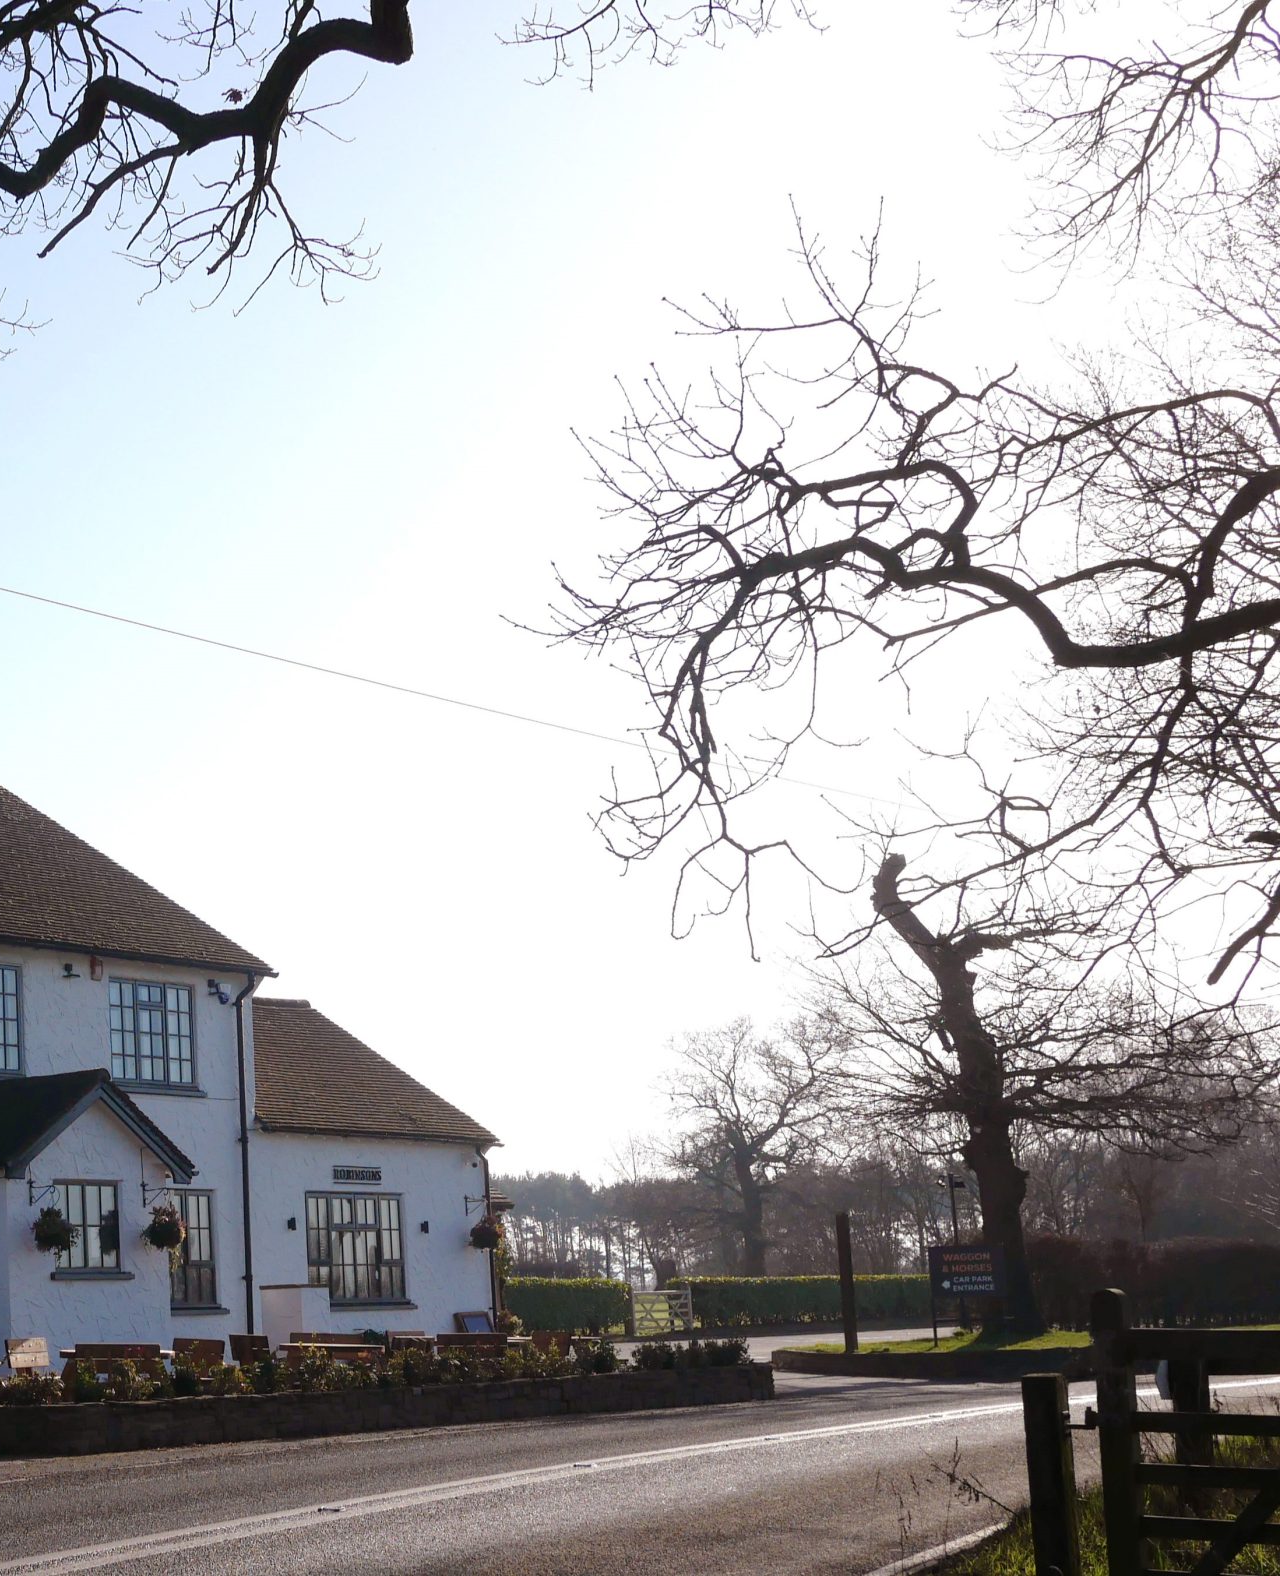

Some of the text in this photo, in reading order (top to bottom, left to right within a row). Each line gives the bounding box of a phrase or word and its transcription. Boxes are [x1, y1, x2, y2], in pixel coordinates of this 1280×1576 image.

[333, 1168, 381, 1181] ROBINSONS
[942, 1252, 990, 1261] WAGGON
[942, 1263, 993, 1273] & HORSES
[952, 1283, 995, 1292] ENTRANCE
